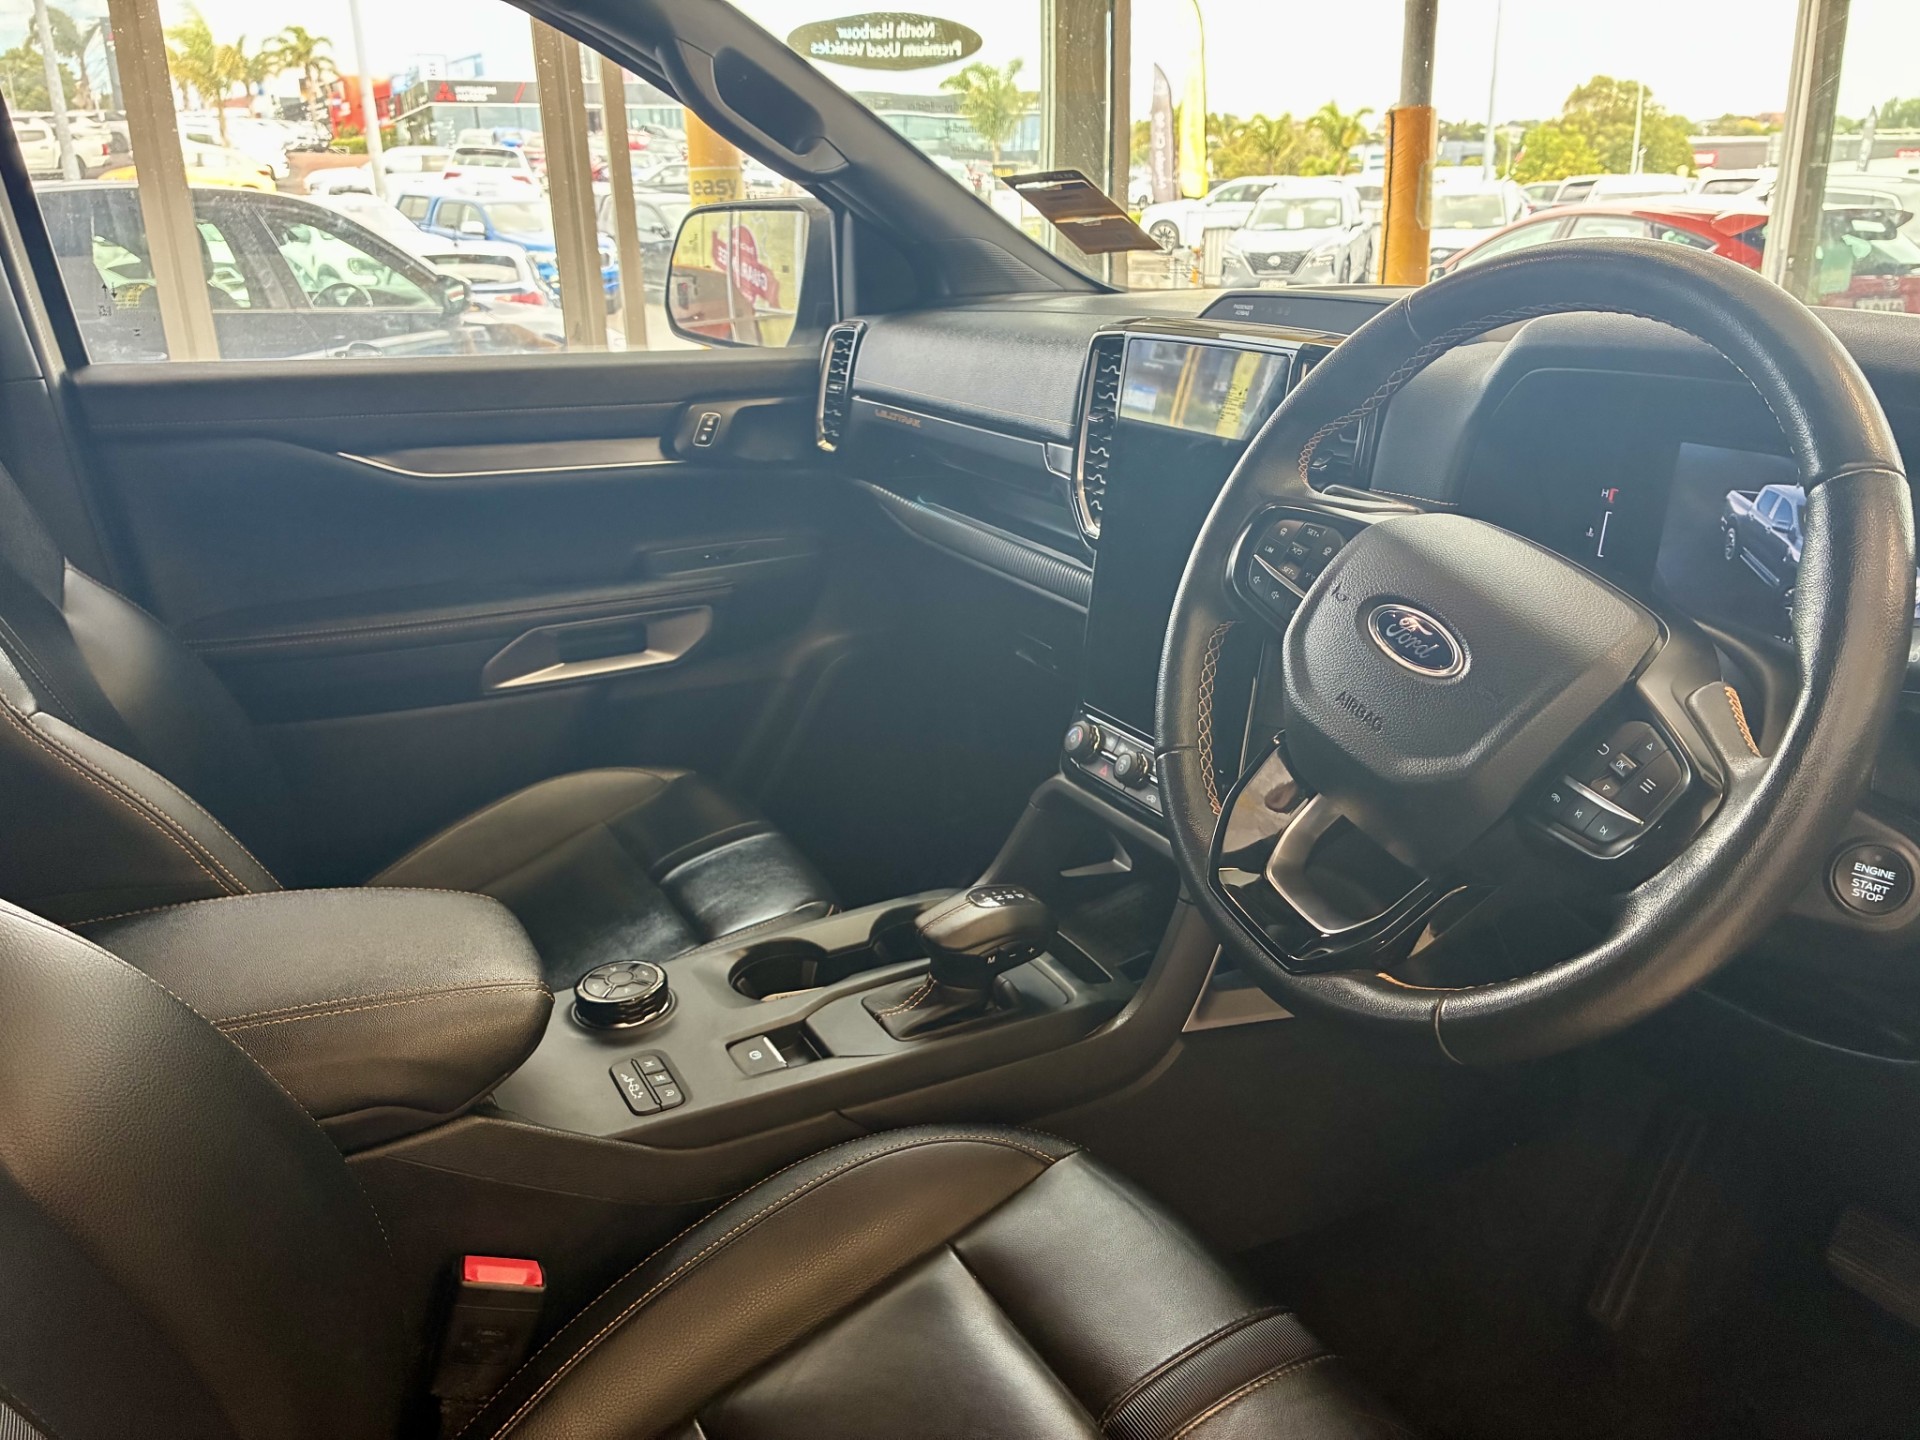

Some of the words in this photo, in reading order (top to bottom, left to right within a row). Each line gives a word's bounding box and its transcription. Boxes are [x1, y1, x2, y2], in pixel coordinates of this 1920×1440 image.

[693, 178, 737, 199] easy
[1601, 488, 1610, 498] H
[1385, 616, 1440, 659] Ford
[1335, 690, 1384, 734] AIRBAG
[1616, 759, 1628, 770] OK
[1853, 861, 1897, 881] ENGINE
[1850, 877, 1891, 895] START
[1851, 887, 1884, 903] STOP
